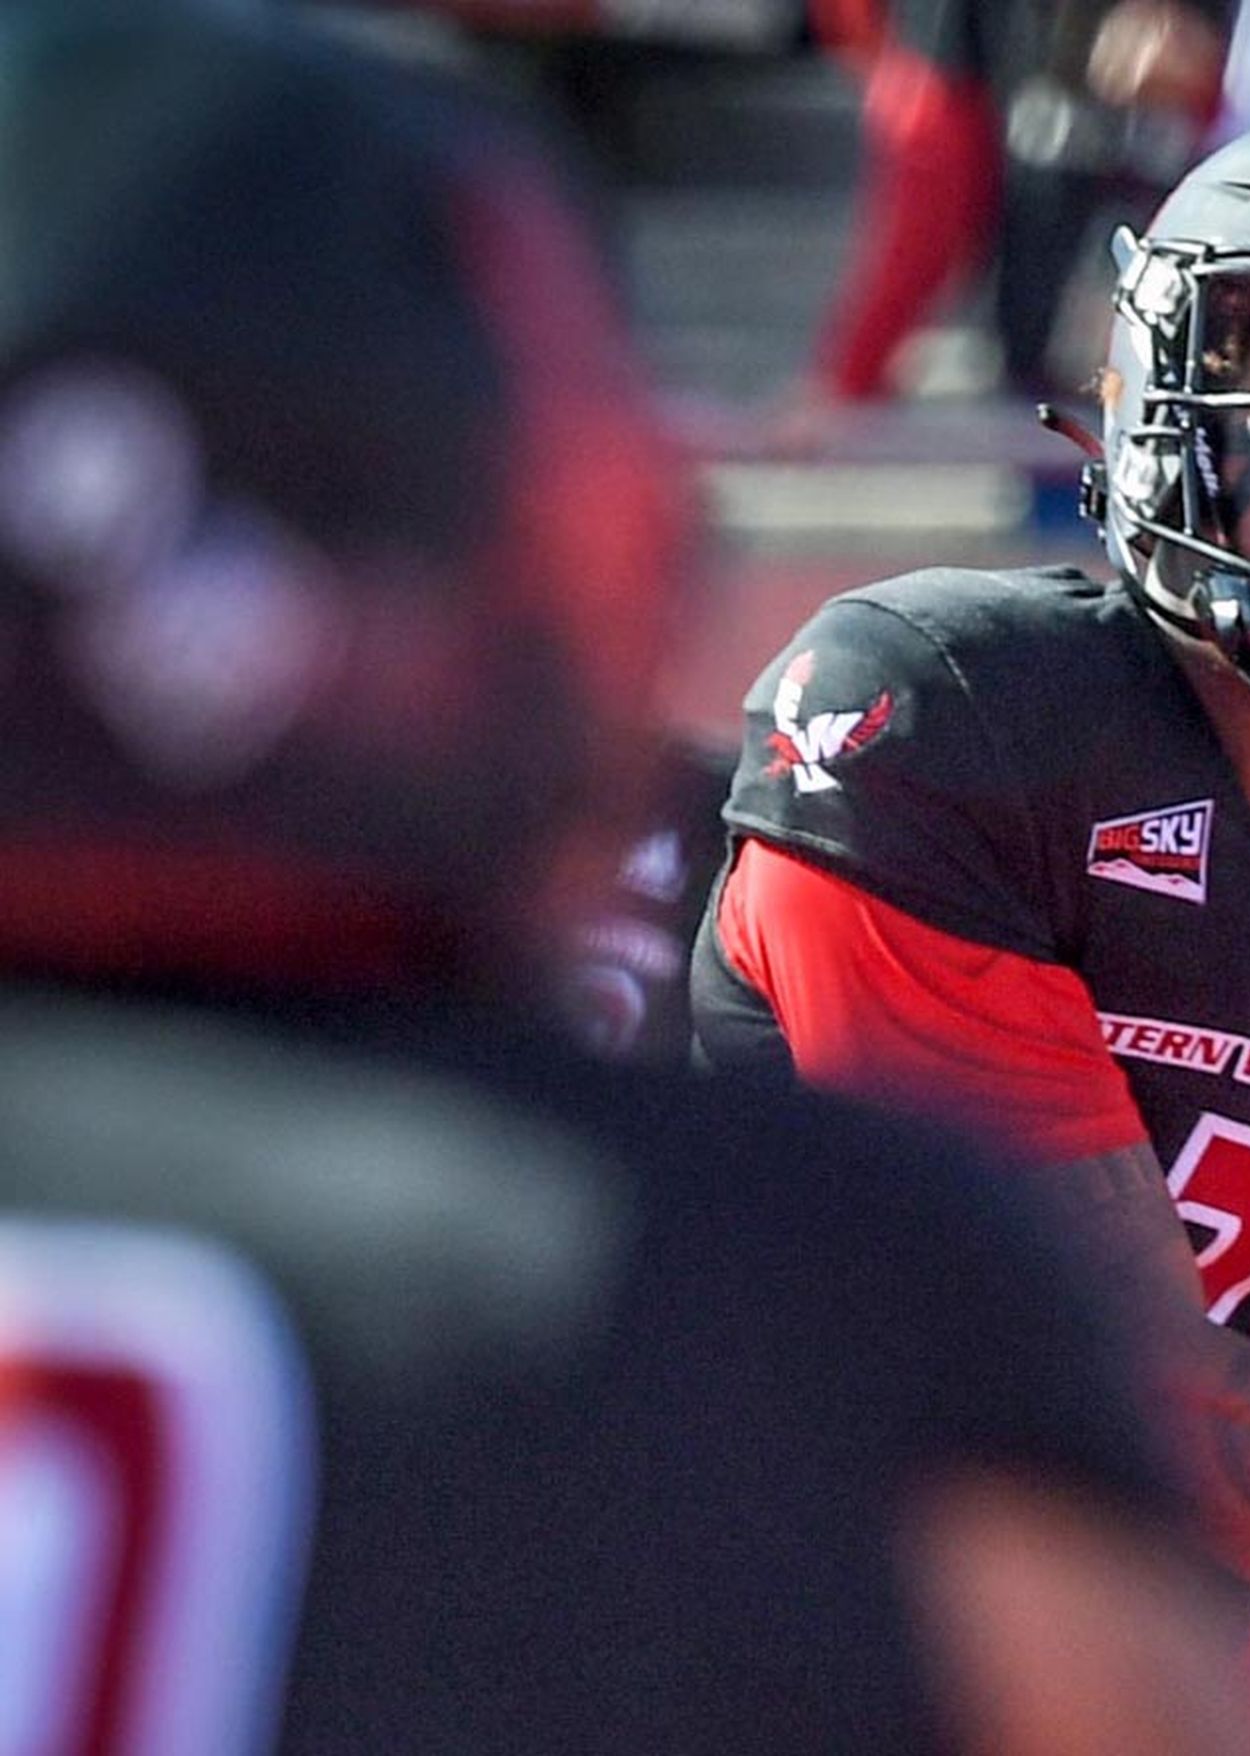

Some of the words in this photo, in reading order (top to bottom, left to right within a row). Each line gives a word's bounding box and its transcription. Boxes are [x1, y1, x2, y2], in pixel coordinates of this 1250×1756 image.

[1097, 824, 1140, 851] BIG
[1139, 811, 1204, 857] SKY
[1098, 1019, 1230, 1067] TERN
